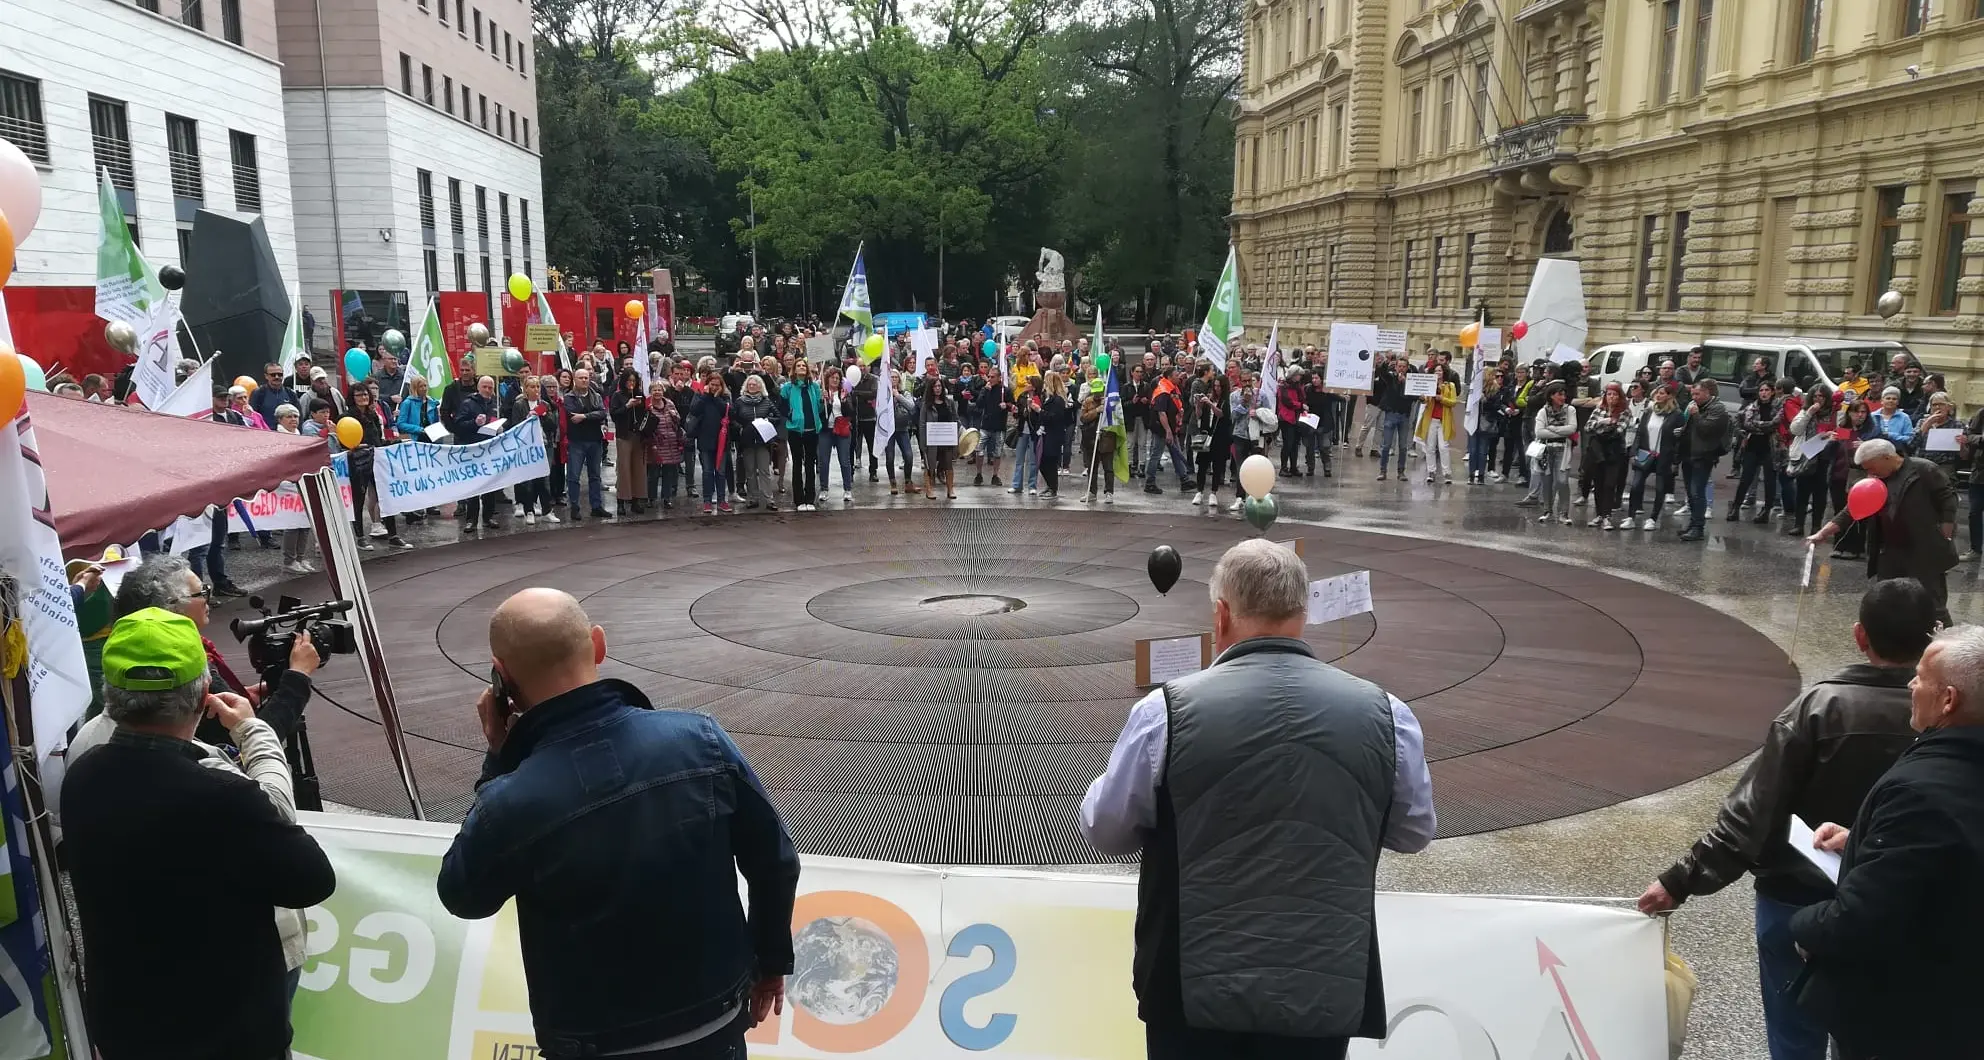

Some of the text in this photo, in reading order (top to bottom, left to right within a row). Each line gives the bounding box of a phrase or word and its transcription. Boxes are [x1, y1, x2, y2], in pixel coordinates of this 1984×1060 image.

[385, 442, 443, 477] MEHR
[415, 475, 436, 492] UNS
[491, 445, 545, 474] FAMILIEN
